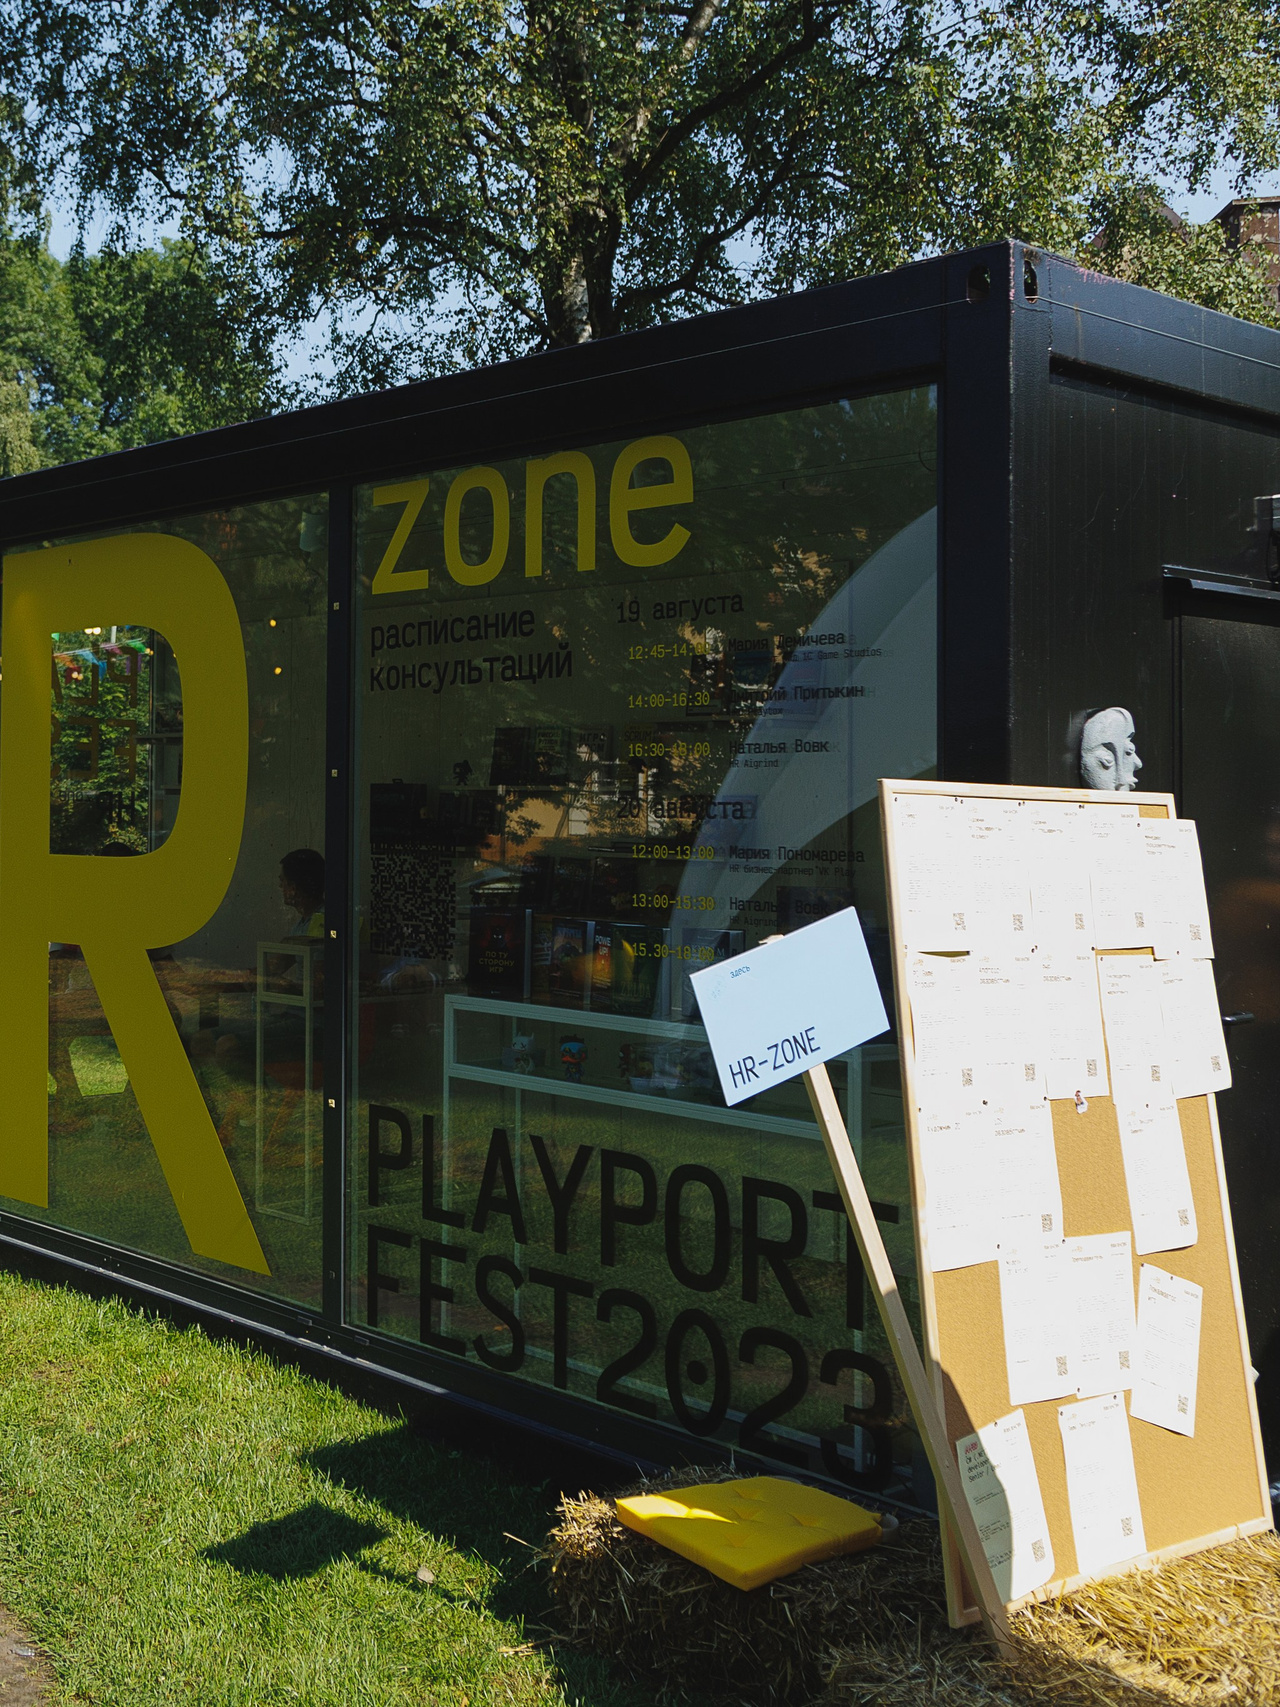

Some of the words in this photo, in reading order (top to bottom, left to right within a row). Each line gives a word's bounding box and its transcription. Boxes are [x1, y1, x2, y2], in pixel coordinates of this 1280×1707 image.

[371, 435, 694, 595] zone
[616, 601, 640, 624] 19
[653, 593, 743, 622] августа
[370, 608, 535, 657] расписание
[628, 642, 711, 661] 12:45-14:00
[728, 638, 769, 653] Мария
[776, 632, 845, 650] Демичева
[370, 642, 573, 693] консультаций
[818, 651, 838, 661] Game
[844, 648, 882, 658] Studios
[628, 691, 710, 709] 14:00-16:30
[794, 685, 864, 702] Притыкин
[628, 741, 711, 758] 16:30-18:00
[729, 740, 786, 754] Наталья
[795, 738, 830, 753] Вовк
[744, 757, 779, 770] Aigrind
[615, 797, 640, 819] 20
[654, 799, 744, 822] августа
[631, 845, 714, 860] 12:00-13:00
[729, 846, 770, 861] Мария
[778, 846, 865, 863] Пономарева
[632, 893, 714, 910] 13:00-15:30
[729, 1027, 821, 1089] HR-ZONE
[367, 1104, 899, 1331] PLAYPORT
[366, 1224, 893, 1491] FEST2023
